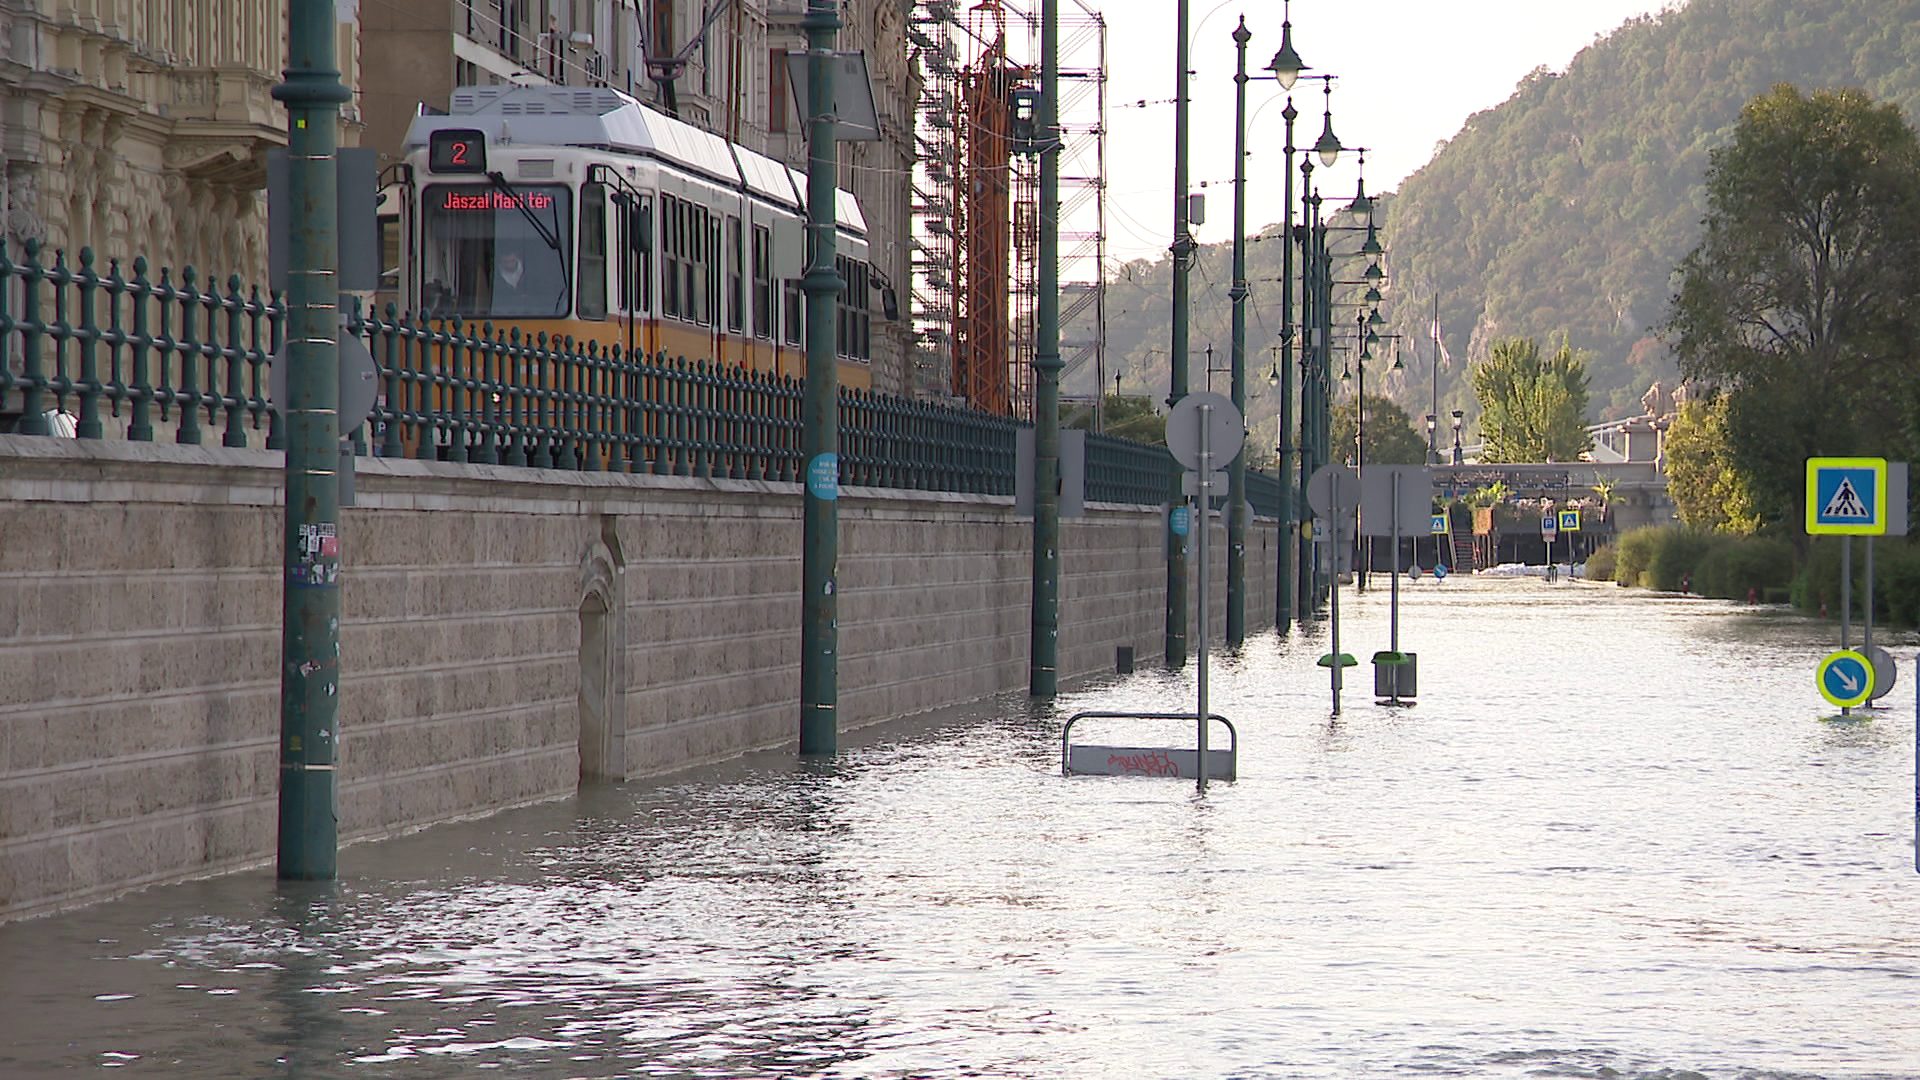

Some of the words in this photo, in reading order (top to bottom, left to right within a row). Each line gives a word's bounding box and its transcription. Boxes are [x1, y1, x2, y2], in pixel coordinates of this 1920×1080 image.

[452, 143, 466, 164] 2
[444, 192, 489, 209] Jászai
[493, 192, 524, 209] Mari
[528, 192, 551, 209] tér
[378, 422, 386, 432] P
[1545, 520, 1552, 528] P
